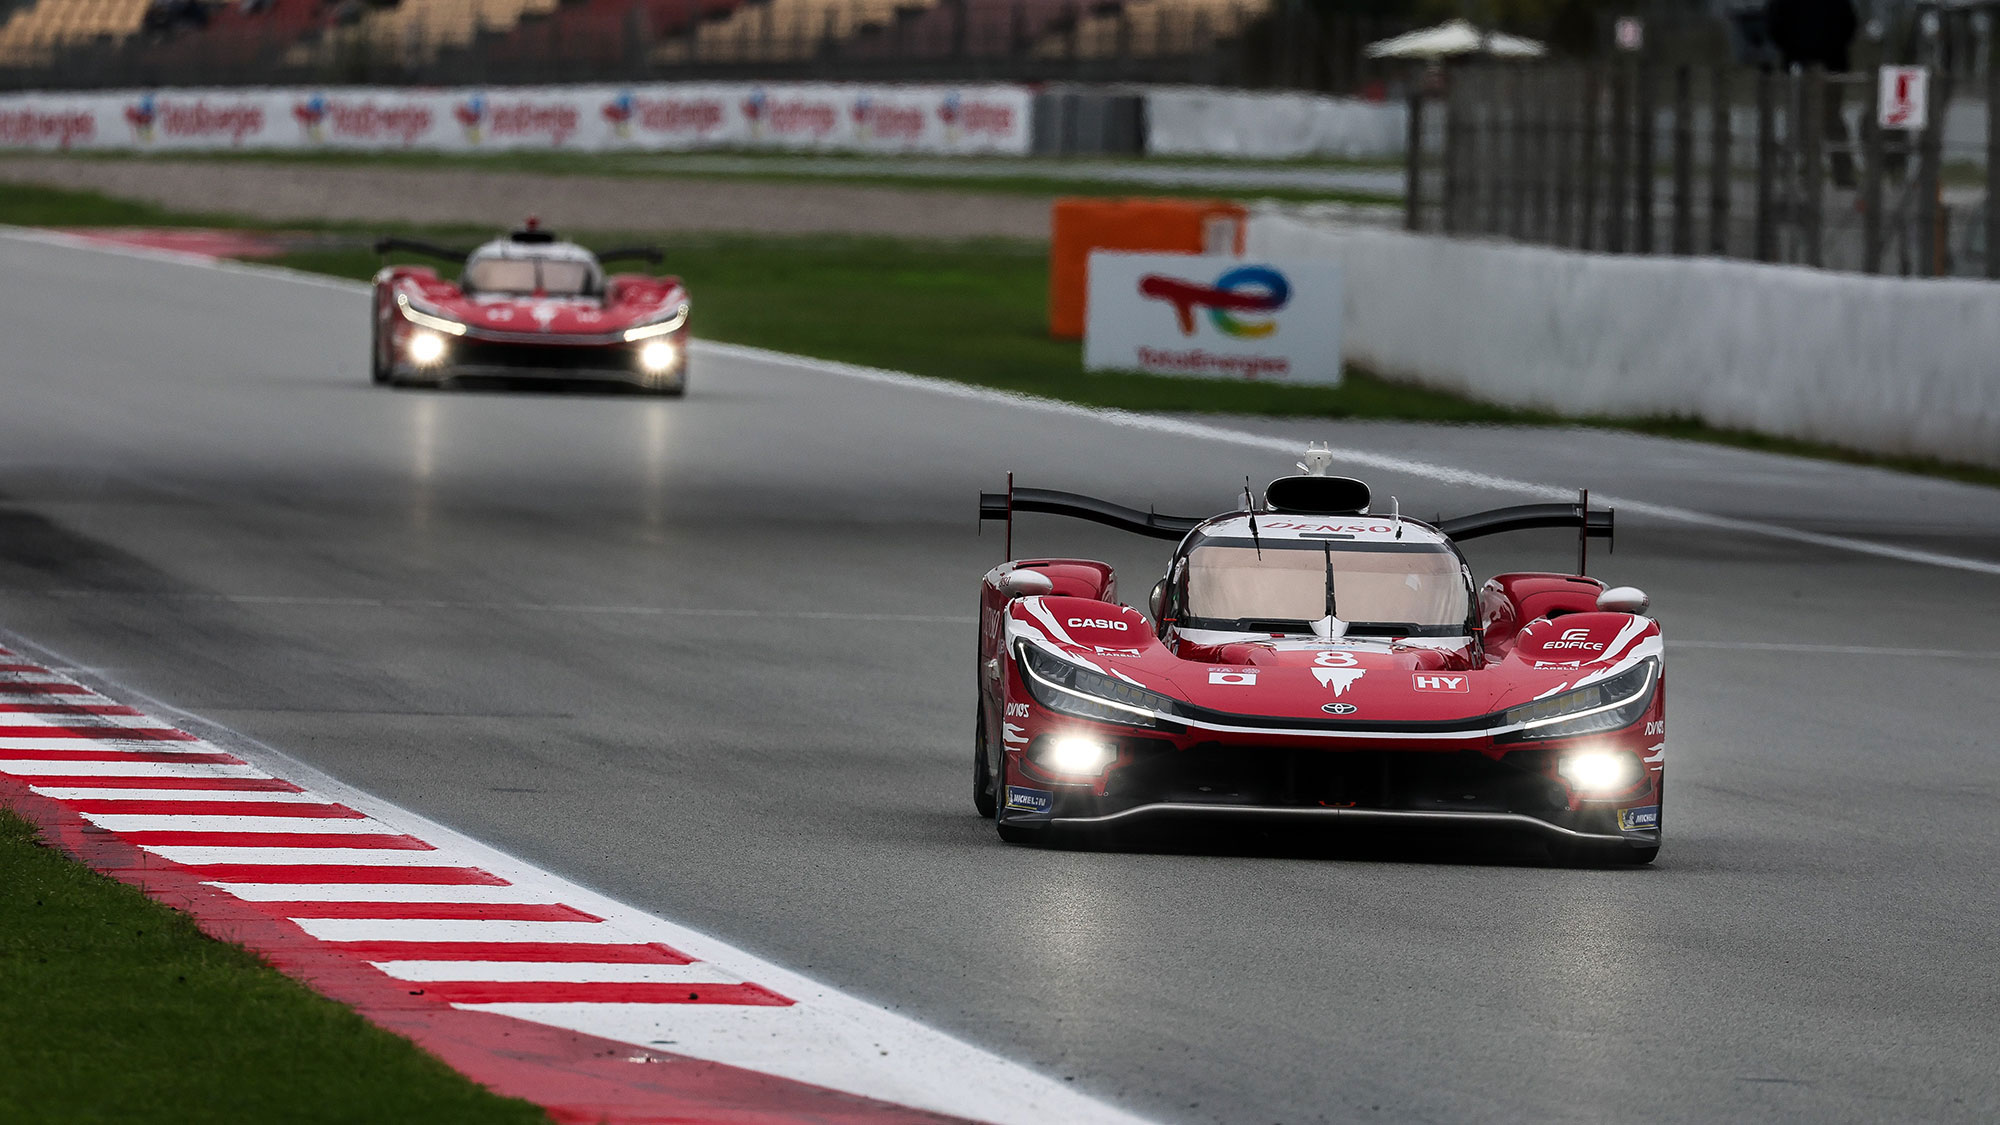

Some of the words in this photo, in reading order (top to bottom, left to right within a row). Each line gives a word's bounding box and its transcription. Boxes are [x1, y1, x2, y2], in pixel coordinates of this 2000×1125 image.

[1263, 522, 1392, 533] DENSO
[1067, 617, 1128, 631] CASIO
[1542, 641, 1604, 651] EDIFICE
[1314, 651, 1359, 667] 8
[1415, 676, 1463, 690] HY
[1013, 793, 1046, 807] MICHELIN
